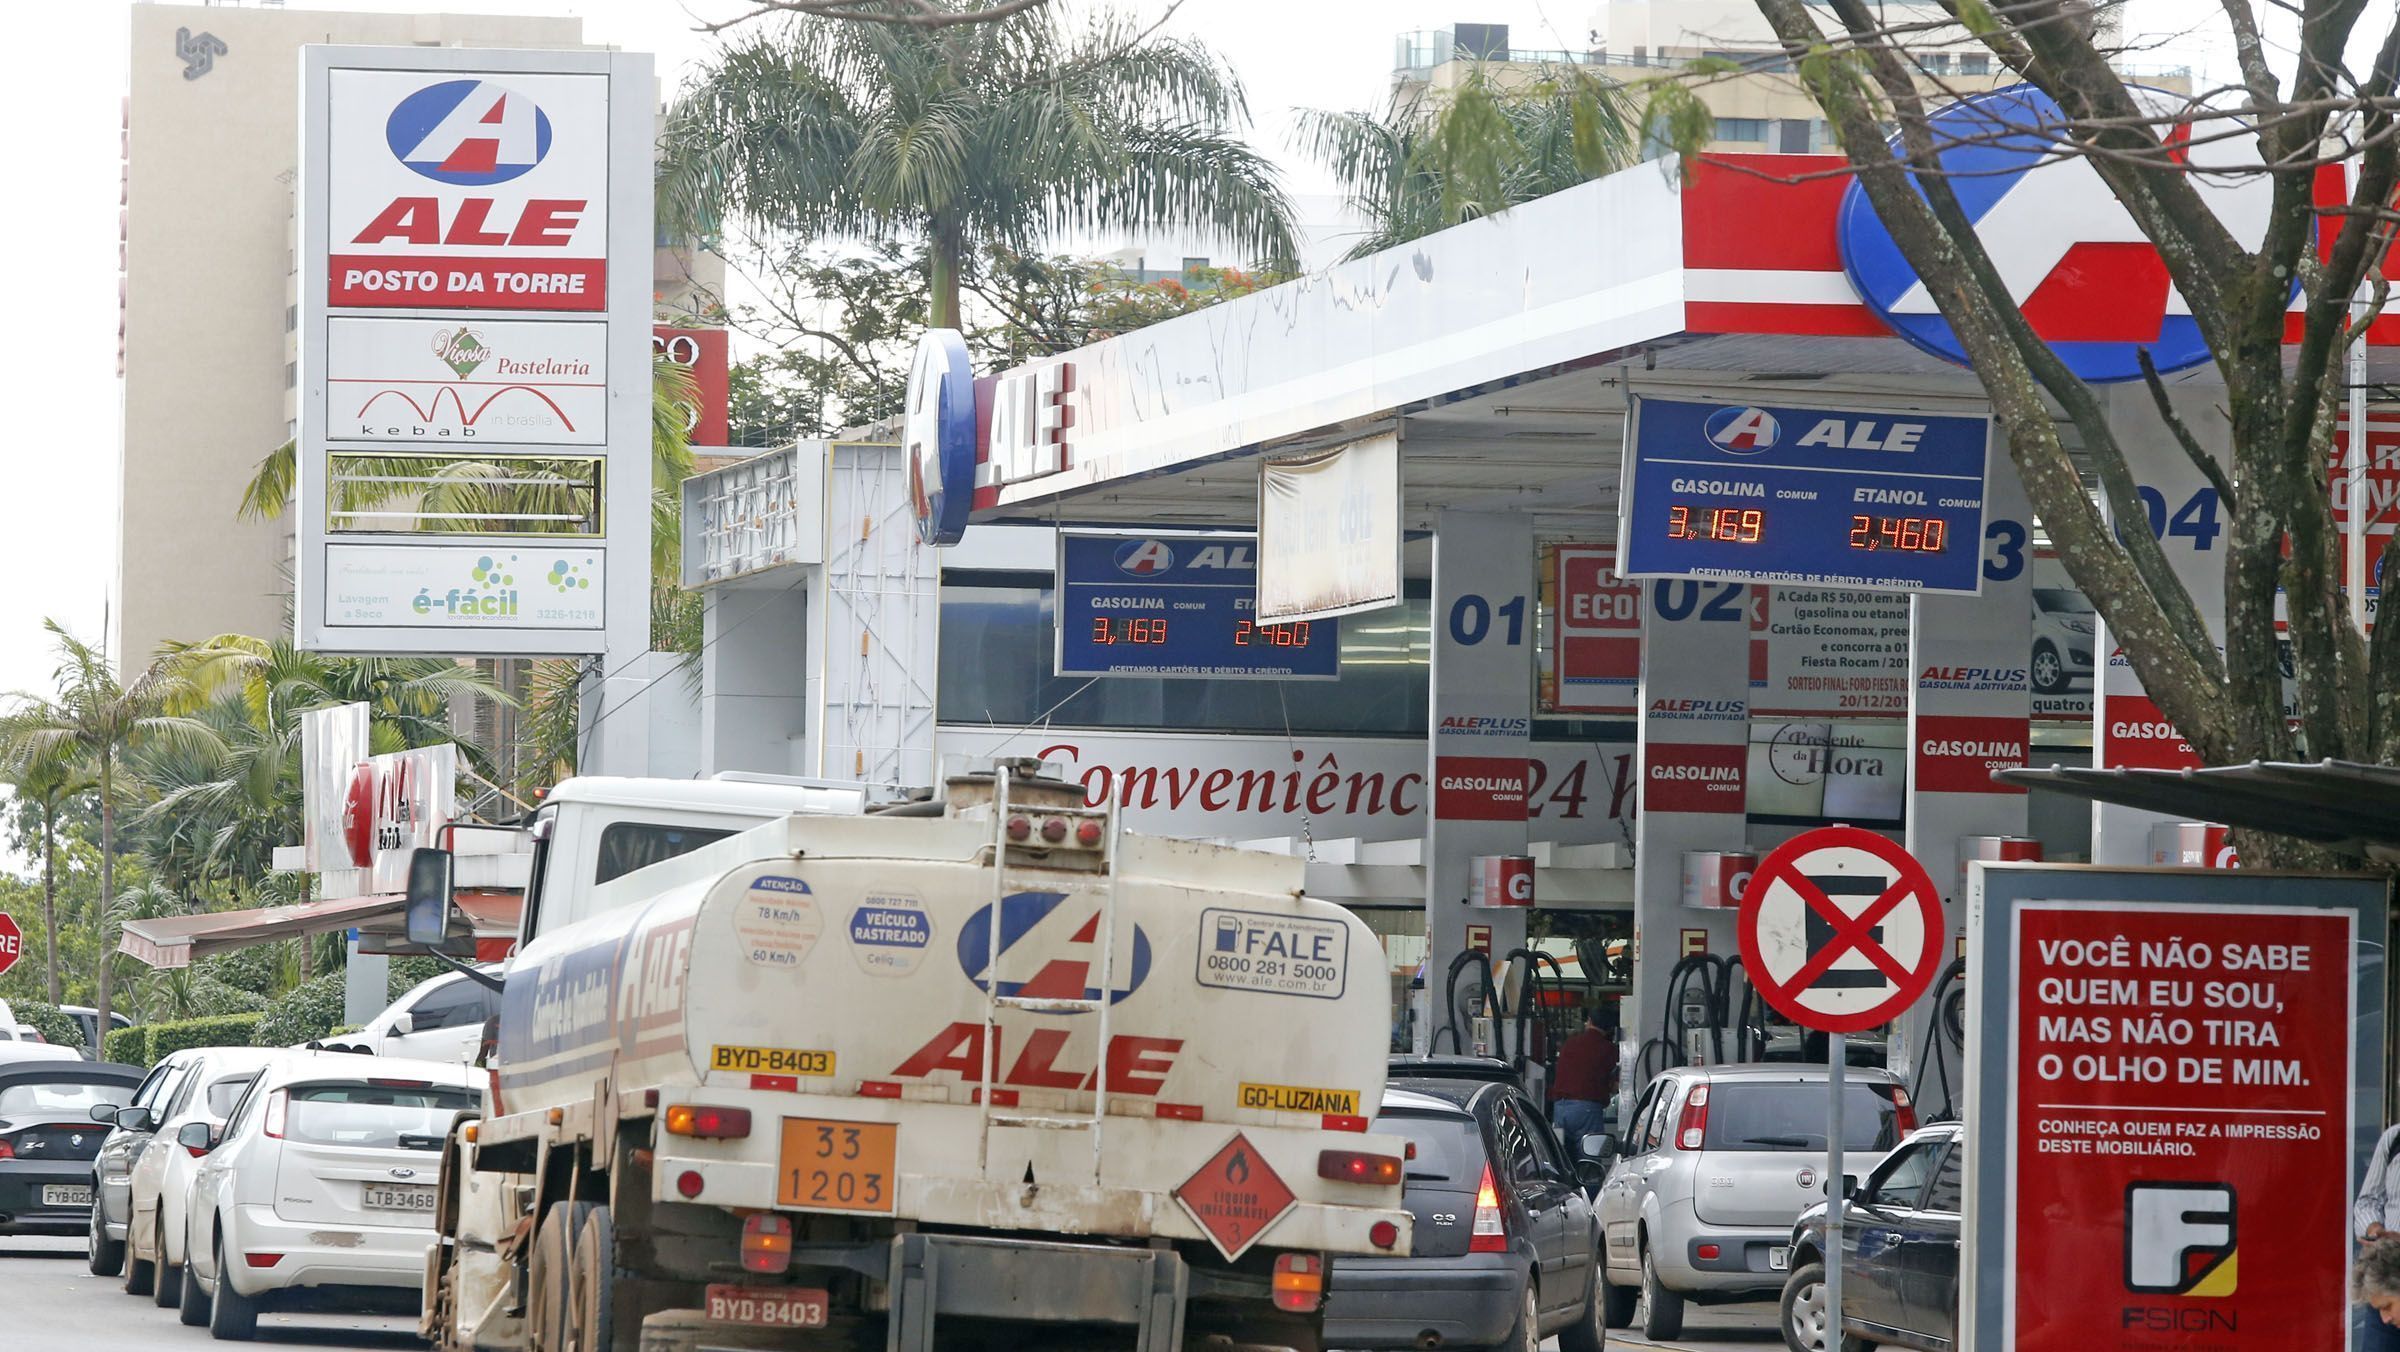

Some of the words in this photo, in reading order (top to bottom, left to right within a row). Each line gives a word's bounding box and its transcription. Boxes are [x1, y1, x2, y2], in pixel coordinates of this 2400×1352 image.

[350, 197, 588, 246] ALE
[344, 270, 438, 291] POSTO
[447, 272, 484, 292] DA
[494, 273, 585, 294] TORRE
[496, 358, 590, 376] Pastelaria
[362, 425, 476, 437] kebab
[1796, 419, 1927, 453] ALE
[1671, 478, 1765, 498] GASOLINA
[1776, 490, 1818, 501] COMUM
[1853, 487, 1928, 506] ETANOL
[1938, 498, 1981, 509] COMUM
[1668, 505, 1762, 543] 3,169
[1849, 515, 1944, 552] 2,460
[1186, 546, 1257, 569] AL
[1983, 519, 2026, 582] 3
[1689, 567, 1751, 580] ACEITAMOS
[1806, 573, 1821, 583] DE
[1824, 573, 1864, 586] DÉBITO
[1876, 576, 1924, 589] CRÉDITO
[338, 594, 390, 607] Lavagem
[412, 588, 518, 615] é-fácil
[1091, 597, 1165, 609] GASOLINA
[1173, 602, 1205, 610] COMUM
[1654, 578, 1744, 622] 02
[1777, 592, 1787, 602] A
[1789, 592, 1818, 603] Cada
[1821, 592, 1836, 604] R$
[1839, 593, 1872, 605] 50,00
[1874, 595, 1893, 604] em
[1895, 593, 1910, 604] ab
[1450, 594, 1525, 646] 01
[1794, 607, 1848, 620] (gasolina
[1851, 610, 1867, 619] ou
[1771, 624, 1811, 636] Cartão
[1813, 625, 1878, 638] Economax,
[1881, 628, 1910, 639] pree
[1821, 644, 1828, 653] e
[1831, 643, 1882, 653] concorra
[1885, 644, 1892, 653] a
[1109, 665, 1158, 673] ACEITAMOS
[1160, 664, 1199, 674] CARTÕES
[1200, 666, 1213, 674] DE
[1214, 665, 1245, 674] DÉBITO
[1247, 667, 1254, 675] E
[1255, 665, 1292, 675] CRÉDITO
[1801, 656, 1837, 668] Fiesta
[1839, 657, 1879, 668] Rocam
[1888, 658, 1909, 669] 201
[1920, 666, 2026, 681] ALEPLUS
[1787, 676, 1821, 691] SORTEIO
[1823, 677, 1848, 691] FINAL:
[1849, 677, 1871, 691] FORD
[1872, 677, 1898, 692] FIESTA
[1650, 698, 1745, 713] ALEPLUS
[1839, 695, 1908, 708] 20/12/201
[2033, 698, 2085, 716] quatro
[1440, 716, 1527, 729] ALEPLUS
[2112, 721, 2186, 740] GASOL
[1788, 730, 1865, 748] Presente
[1922, 740, 2022, 758] GASOLINA
[1793, 750, 1808, 761] da
[1806, 748, 1884, 777] Hora
[1985, 761, 2022, 769] COMUM
[1036, 744, 1427, 816] onveniênc
[1651, 765, 1740, 781] GASOLINA
[1441, 777, 1523, 792] GASOLINA
[1706, 783, 1741, 792] COMUM
[1492, 793, 1523, 801] COMUM
[760, 880, 803, 892] ATENÇÃO
[1508, 873, 1532, 900] G
[758, 907, 770, 919] 78
[774, 909, 800, 922] Km/h
[866, 911, 917, 928] VEÍCULO
[854, 927, 925, 943] RASTREADO
[1246, 929, 1333, 962] FALE
[2038, 934, 2131, 967] VOCÊ
[2141, 936, 2212, 969] NÃO
[2221, 943, 2310, 971] SABE
[753, 950, 766, 962] 60
[770, 951, 796, 964] Km/h
[1207, 955, 1250, 973] 0800
[1256, 961, 1286, 976] 281
[1293, 964, 1336, 981] 5000
[1214, 972, 1326, 992] www.ale.com.br
[2038, 977, 2139, 1005] QUEM
[2149, 980, 2193, 1007] EU
[2204, 981, 2284, 1014] SOU,
[2039, 1016, 2112, 1043] MAS
[2122, 1012, 2194, 1045] NÃO
[2203, 1020, 2280, 1047] TIRA
[716, 1048, 827, 1073] BYD-8403
[890, 1022, 1184, 1096] ALE
[2037, 1054, 2064, 1081] O
[2072, 1055, 2167, 1082] OLHO
[2178, 1057, 2223, 1084] DE
[2233, 1059, 2310, 1086] MIM.
[2038, 1119, 2120, 1138] CONHEÇA
[2123, 1121, 2171, 1137] QUEM
[2176, 1123, 2206, 1137] FAZ
[2209, 1124, 2222, 1138] A
[2225, 1123, 2321, 1140] IMPRESSÃO
[816, 1126, 861, 1160] 33
[2038, 1139, 2092, 1155] DESTE
[2096, 1139, 2196, 1156] MOBILIÁRIO.
[792, 1168, 882, 1204] 1203
[1432, 1213, 1456, 1221] C3
[1228, 1222, 1241, 1244] 3
[711, 1298, 821, 1325] BYD-8403
[2122, 1307, 2237, 1333] FSIGN
